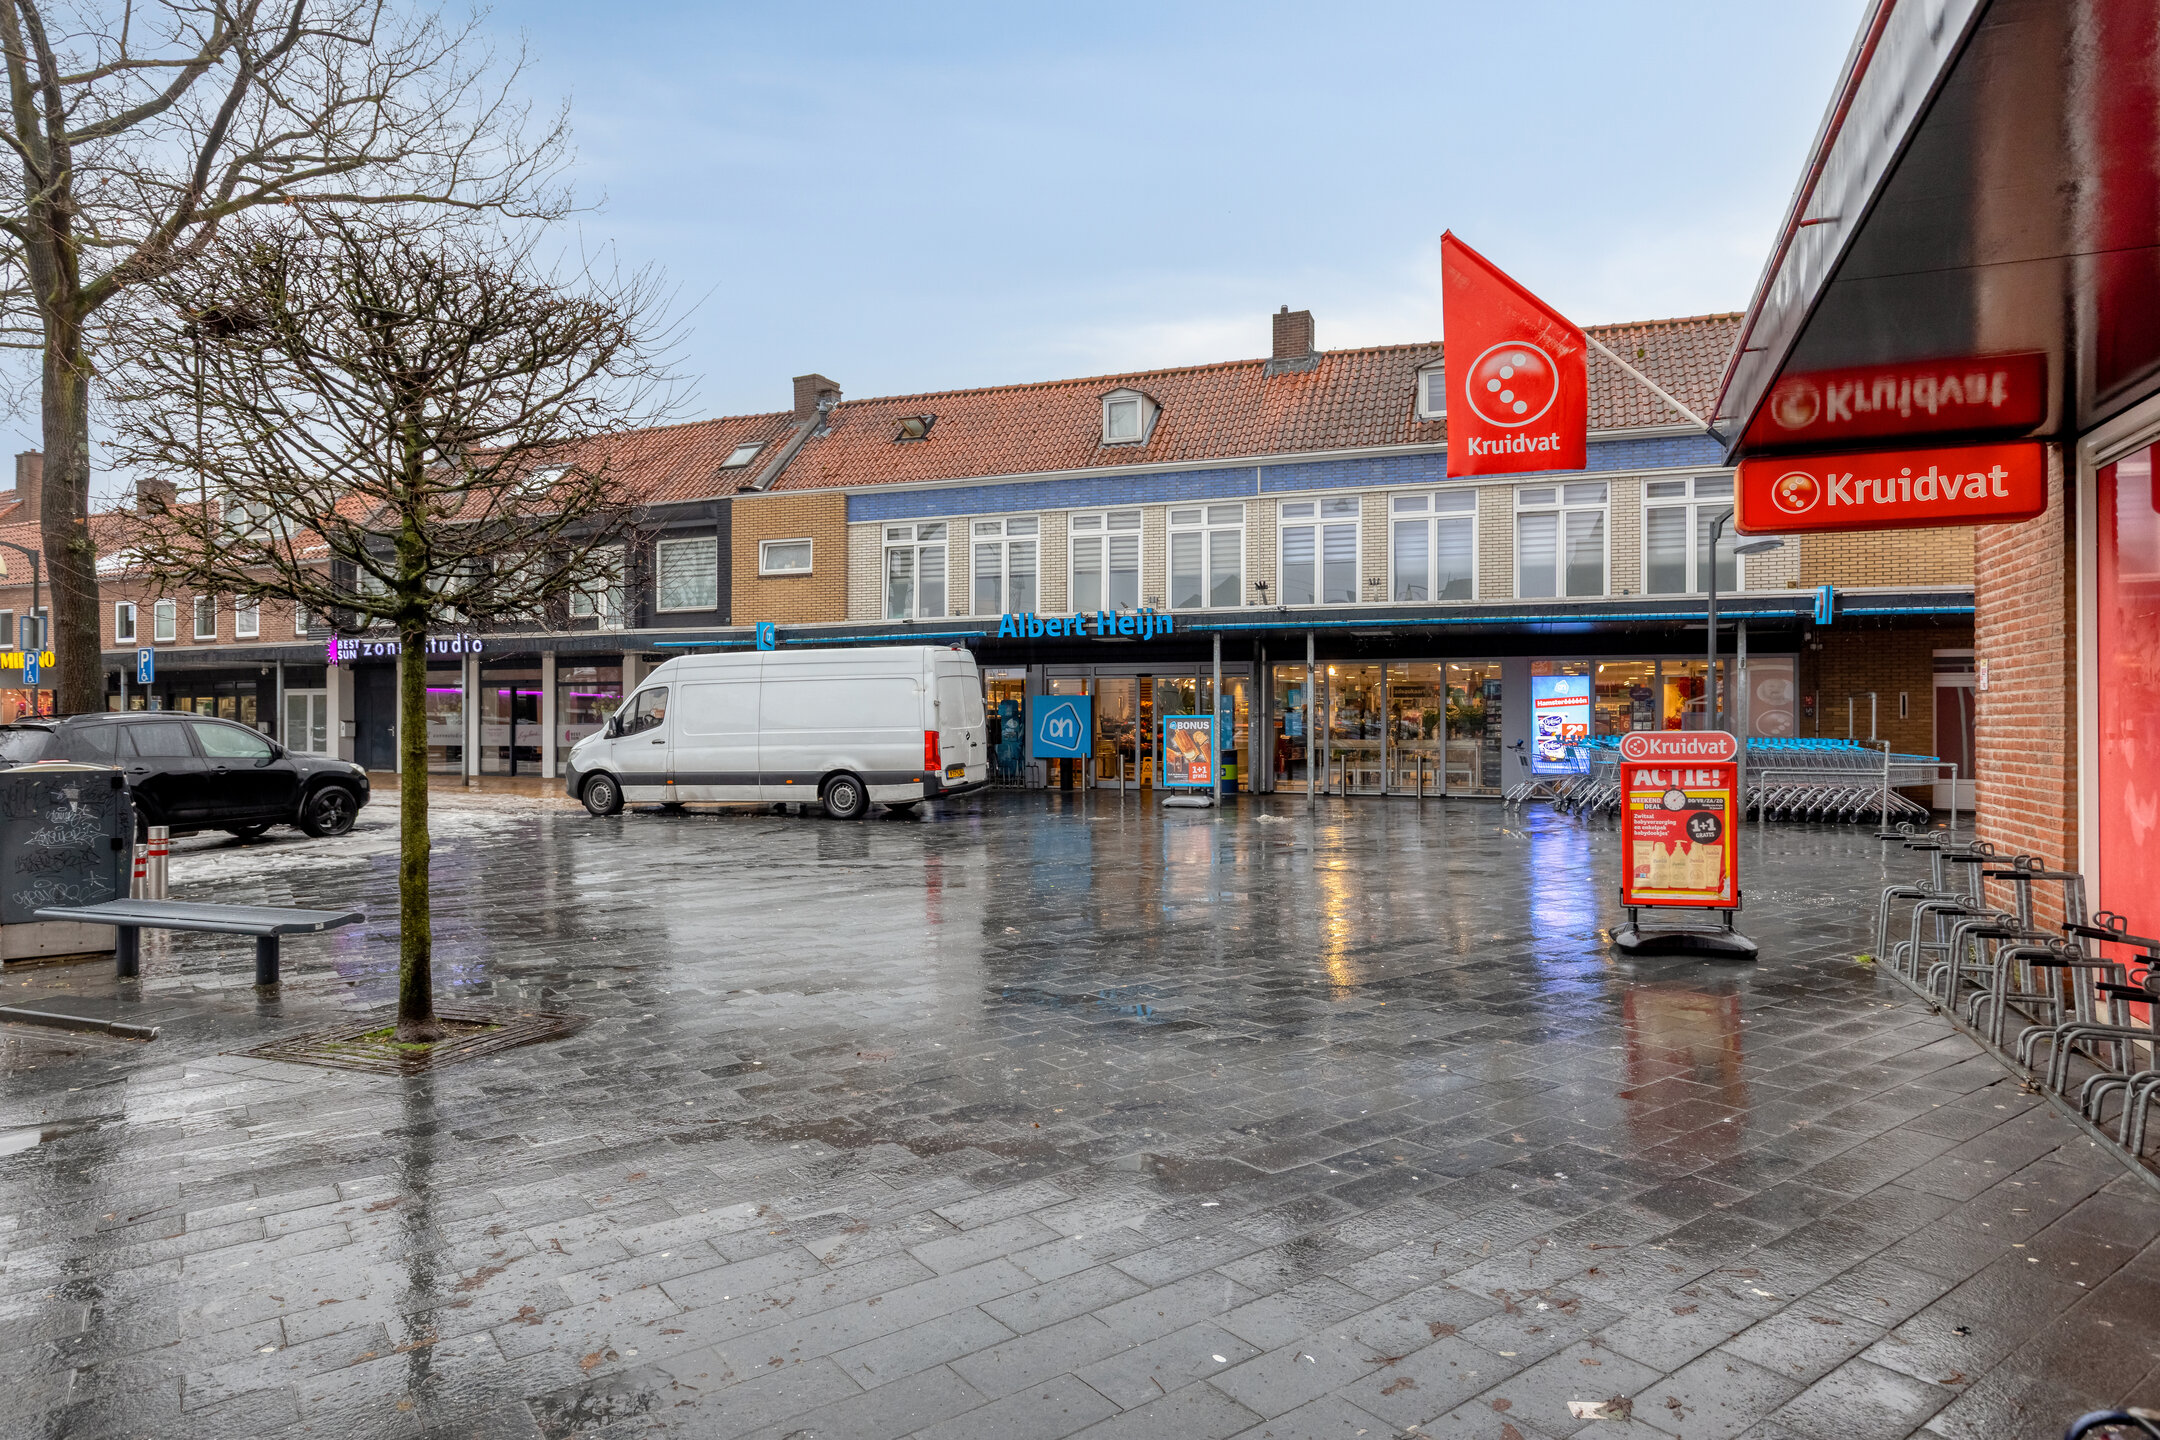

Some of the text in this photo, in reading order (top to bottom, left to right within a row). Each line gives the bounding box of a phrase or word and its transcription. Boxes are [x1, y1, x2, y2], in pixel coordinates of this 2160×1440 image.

[1468, 432, 1560, 456] Kruidvat
[1827, 465, 2009, 506] Kruidvat
[998, 608, 1173, 641] Albert Heijn
[337, 639, 359, 649] BEST
[363, 633, 483, 656] zontudio
[26, 654, 35, 671] P
[140, 651, 149, 669] P
[337, 650, 357, 660] SUN
[1177, 721, 1210, 730] BONUS
[1650, 738, 1727, 755] Kruidvat
[1192, 766, 1207, 774] 1+1
[1633, 769, 1720, 787] ACTIE!
[1690, 818, 1717, 833] 1+1
